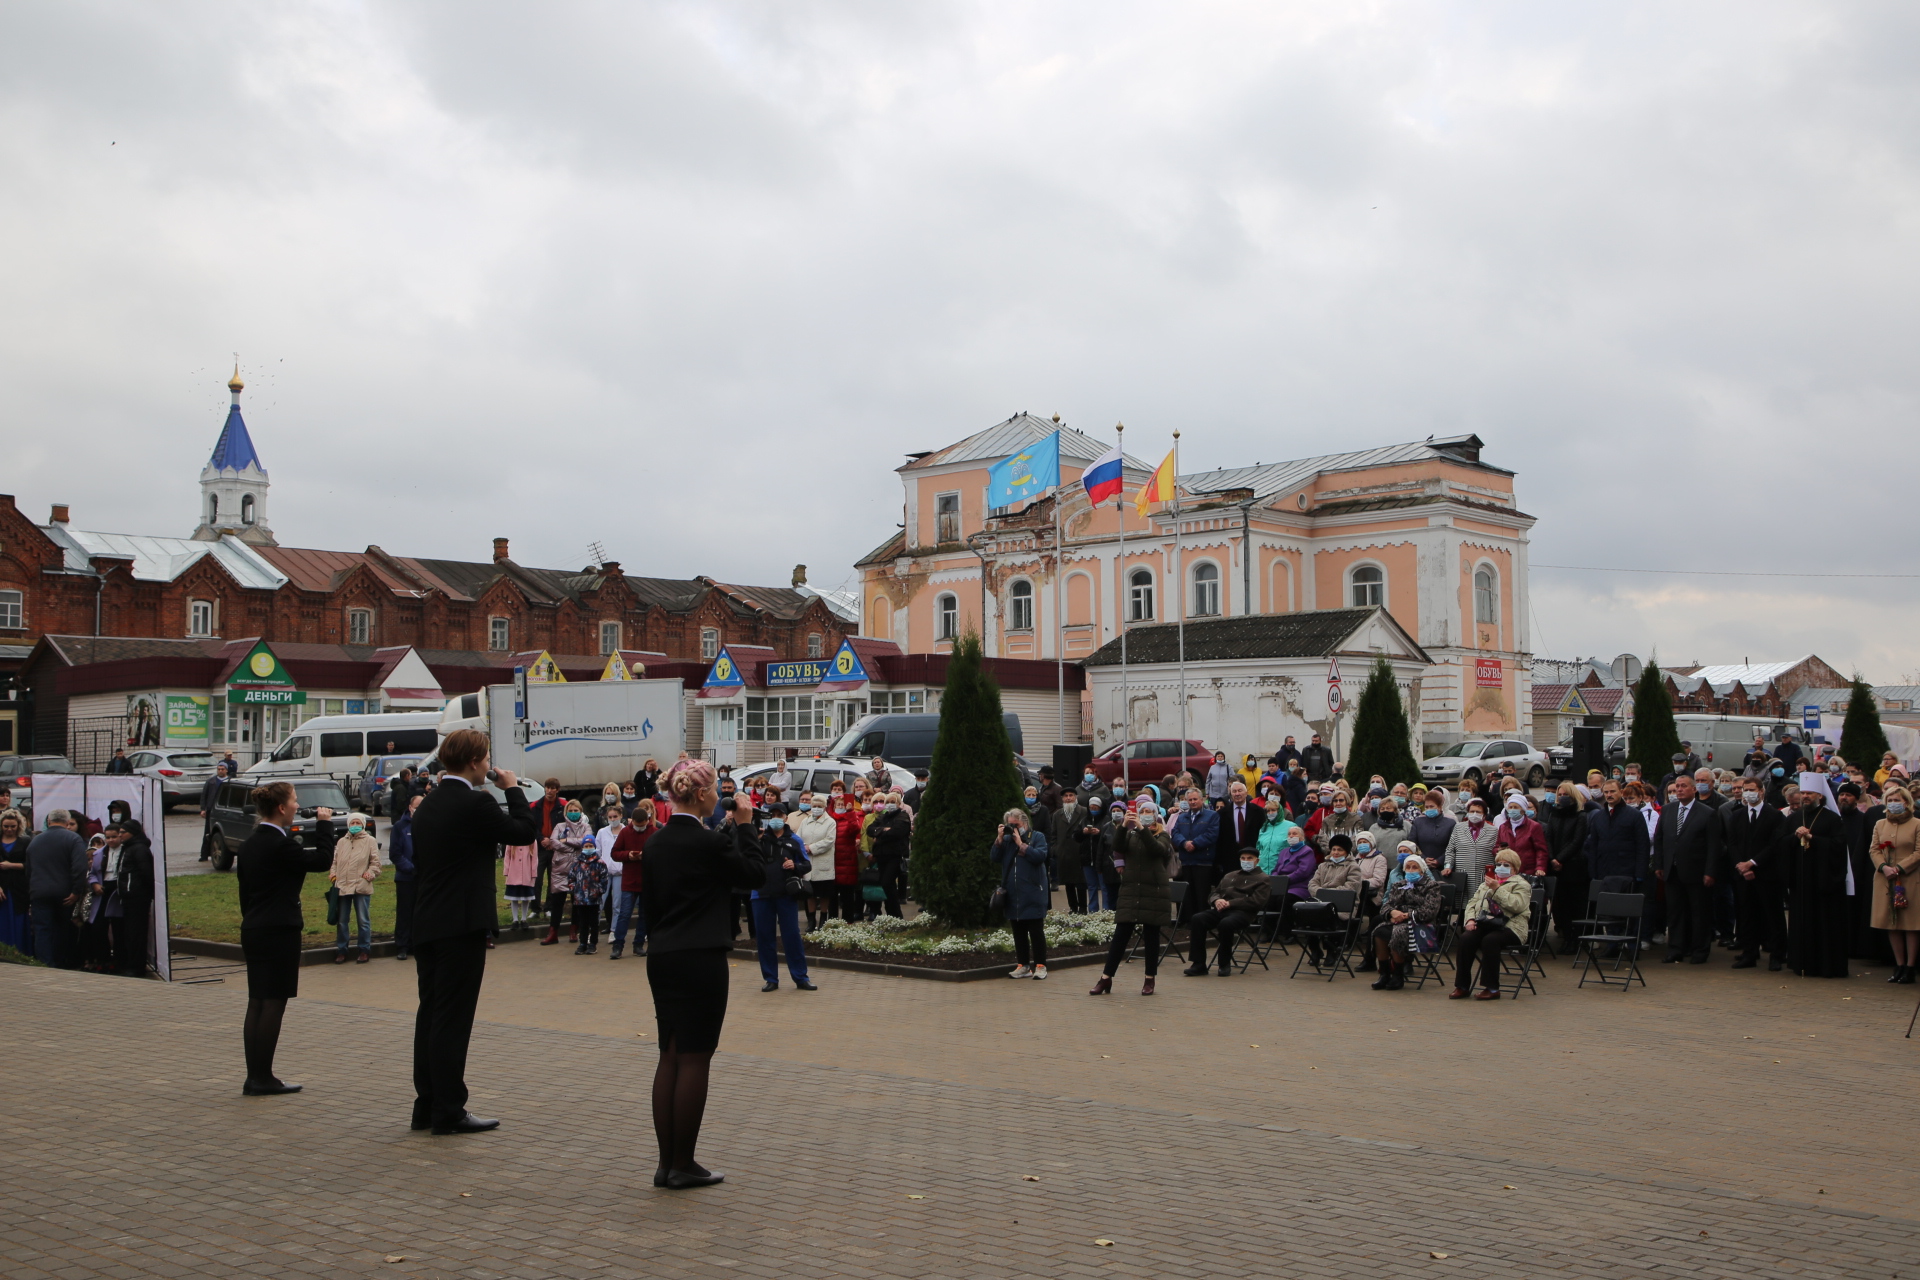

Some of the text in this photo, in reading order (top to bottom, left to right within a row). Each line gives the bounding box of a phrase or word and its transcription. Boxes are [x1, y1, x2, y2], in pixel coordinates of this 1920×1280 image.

[778, 664, 820, 678] ОБУВЬ
[1478, 667, 1502, 678] ОБУВЬ
[245, 691, 292, 702] ДЕНЬГИ
[1331, 692, 1338, 703] 40
[530, 725, 638, 736] егионГазКомплект
